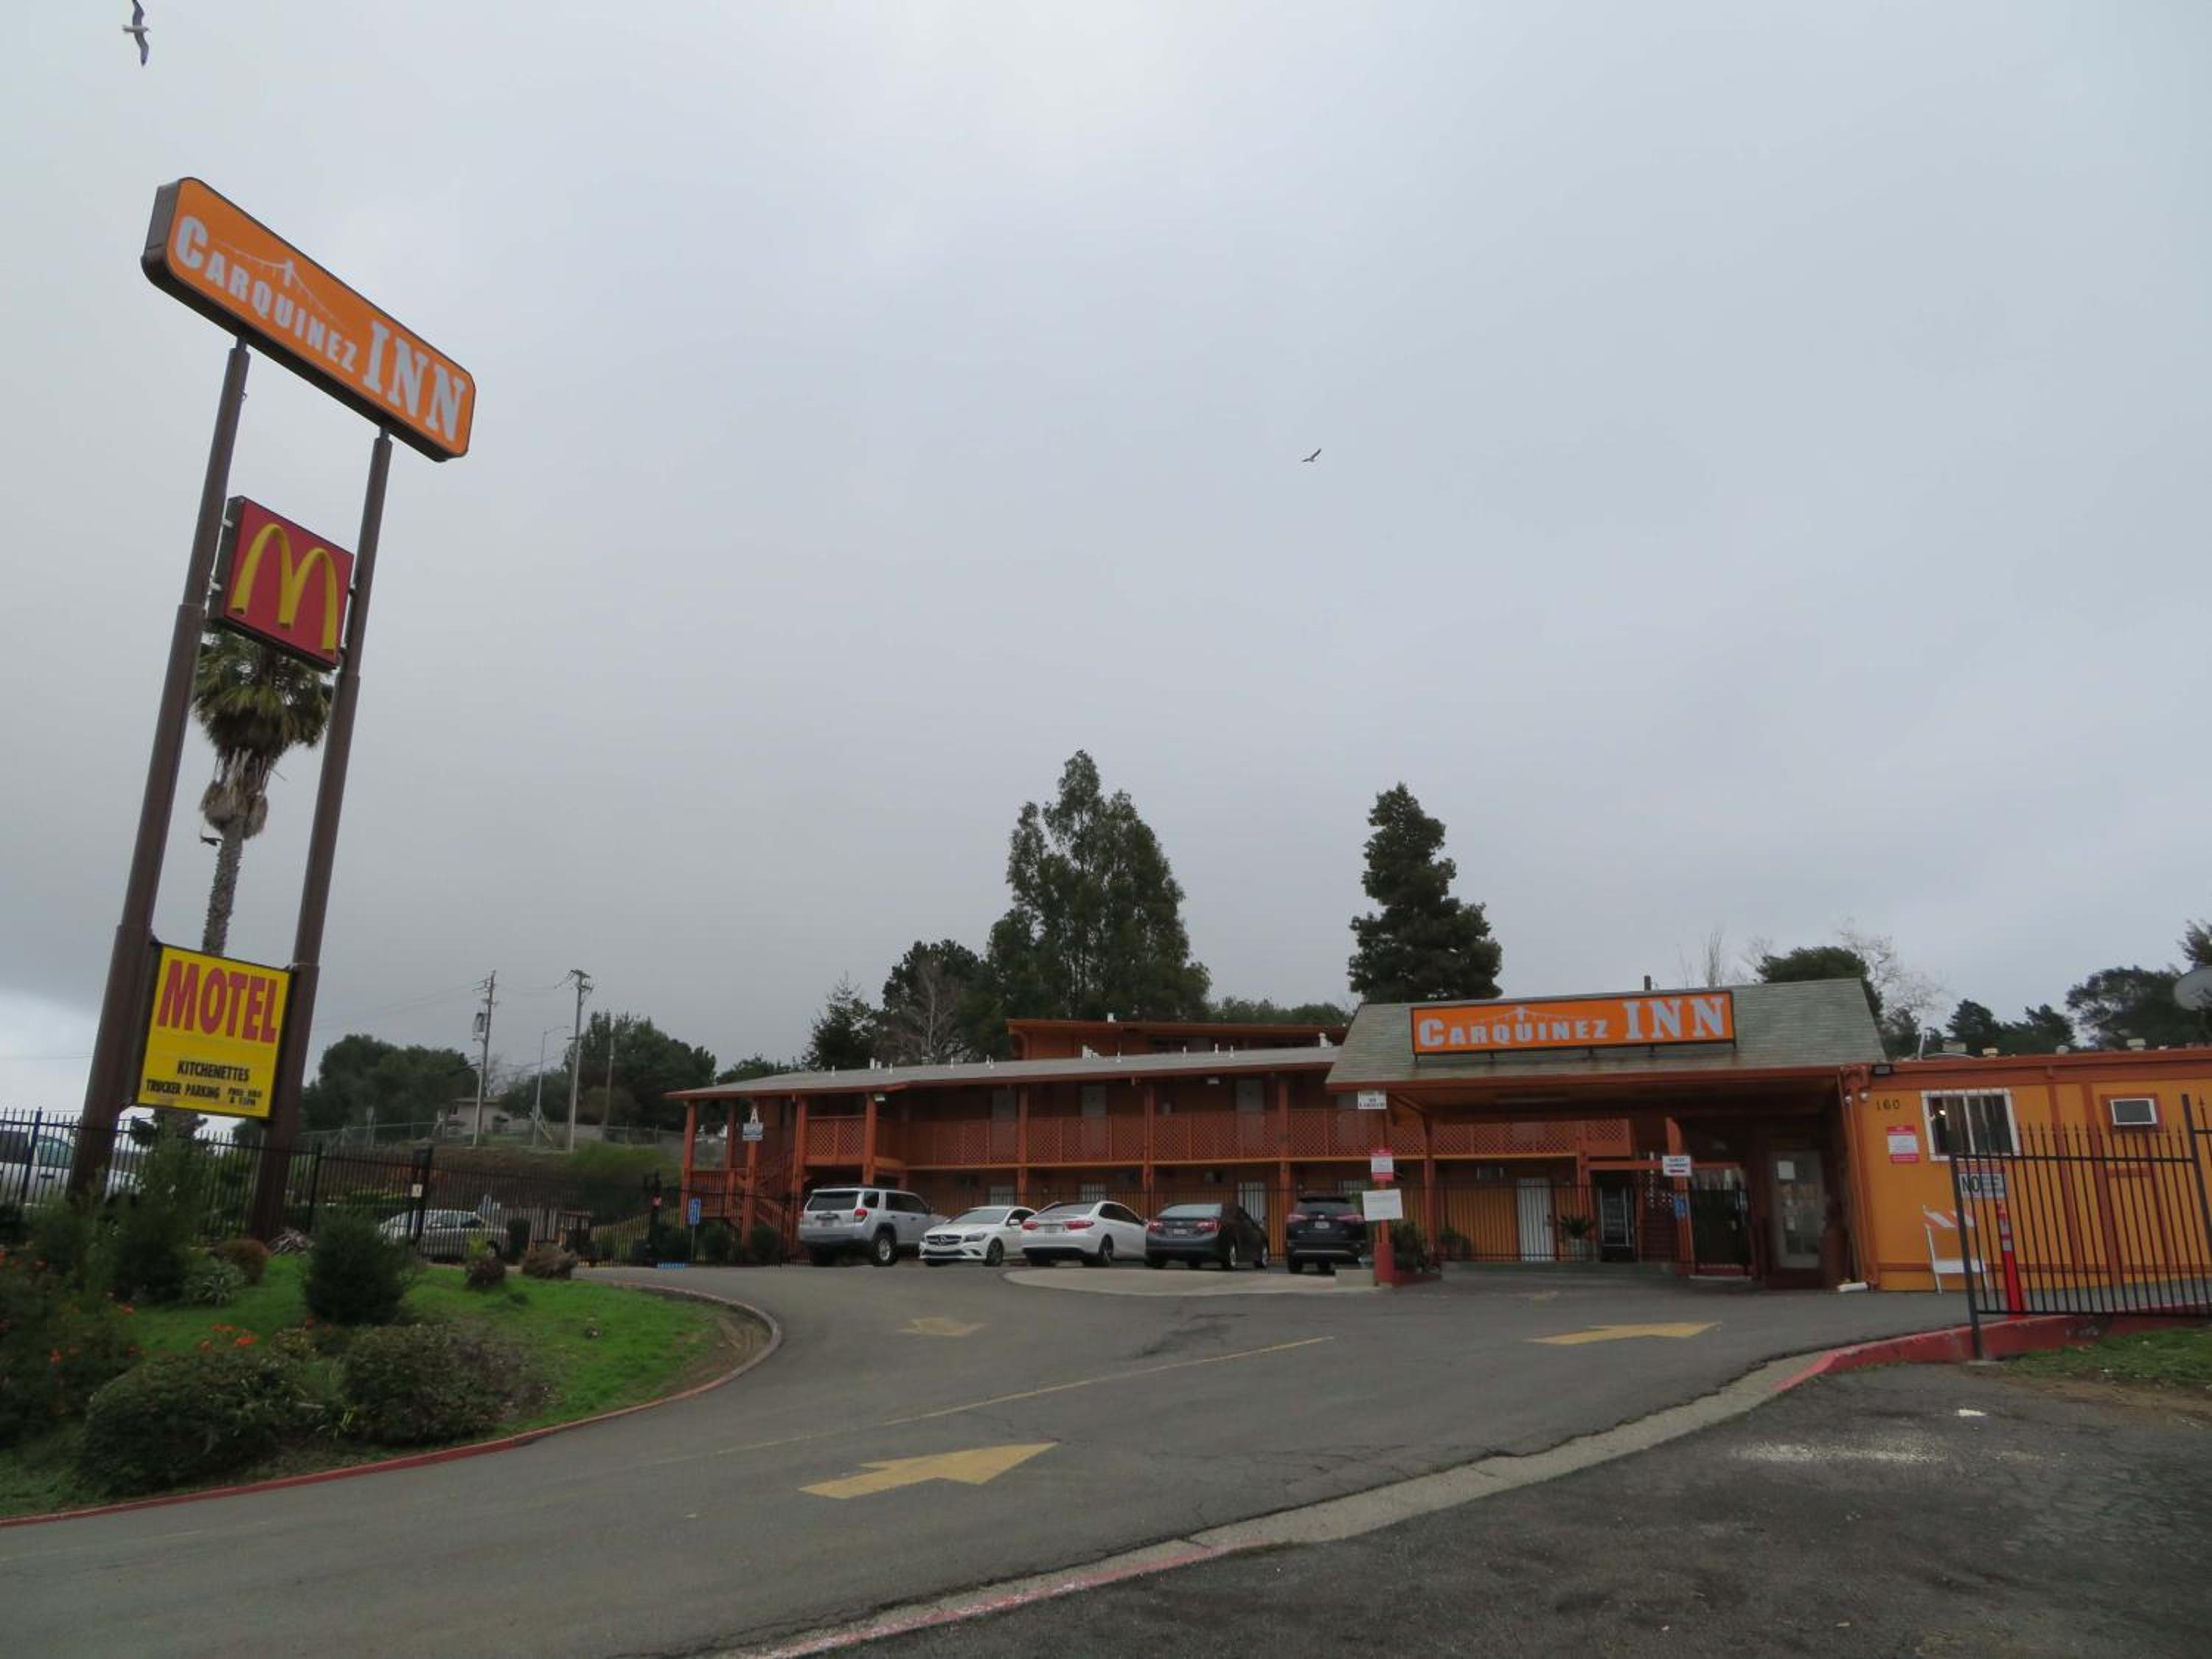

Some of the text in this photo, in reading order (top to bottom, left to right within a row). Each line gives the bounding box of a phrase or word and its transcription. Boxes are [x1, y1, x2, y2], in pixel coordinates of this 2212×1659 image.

[175, 215, 465, 442] CARQUINEZ INN
[157, 959, 278, 1044] MOTEL
[1418, 997, 1724, 1047] CARQUINEZ INN
[146, 1079, 220, 1099] TRUCKER PARKING
[177, 1060, 249, 1082] KITCHENETTES
[1961, 1175, 1980, 1192] NO
